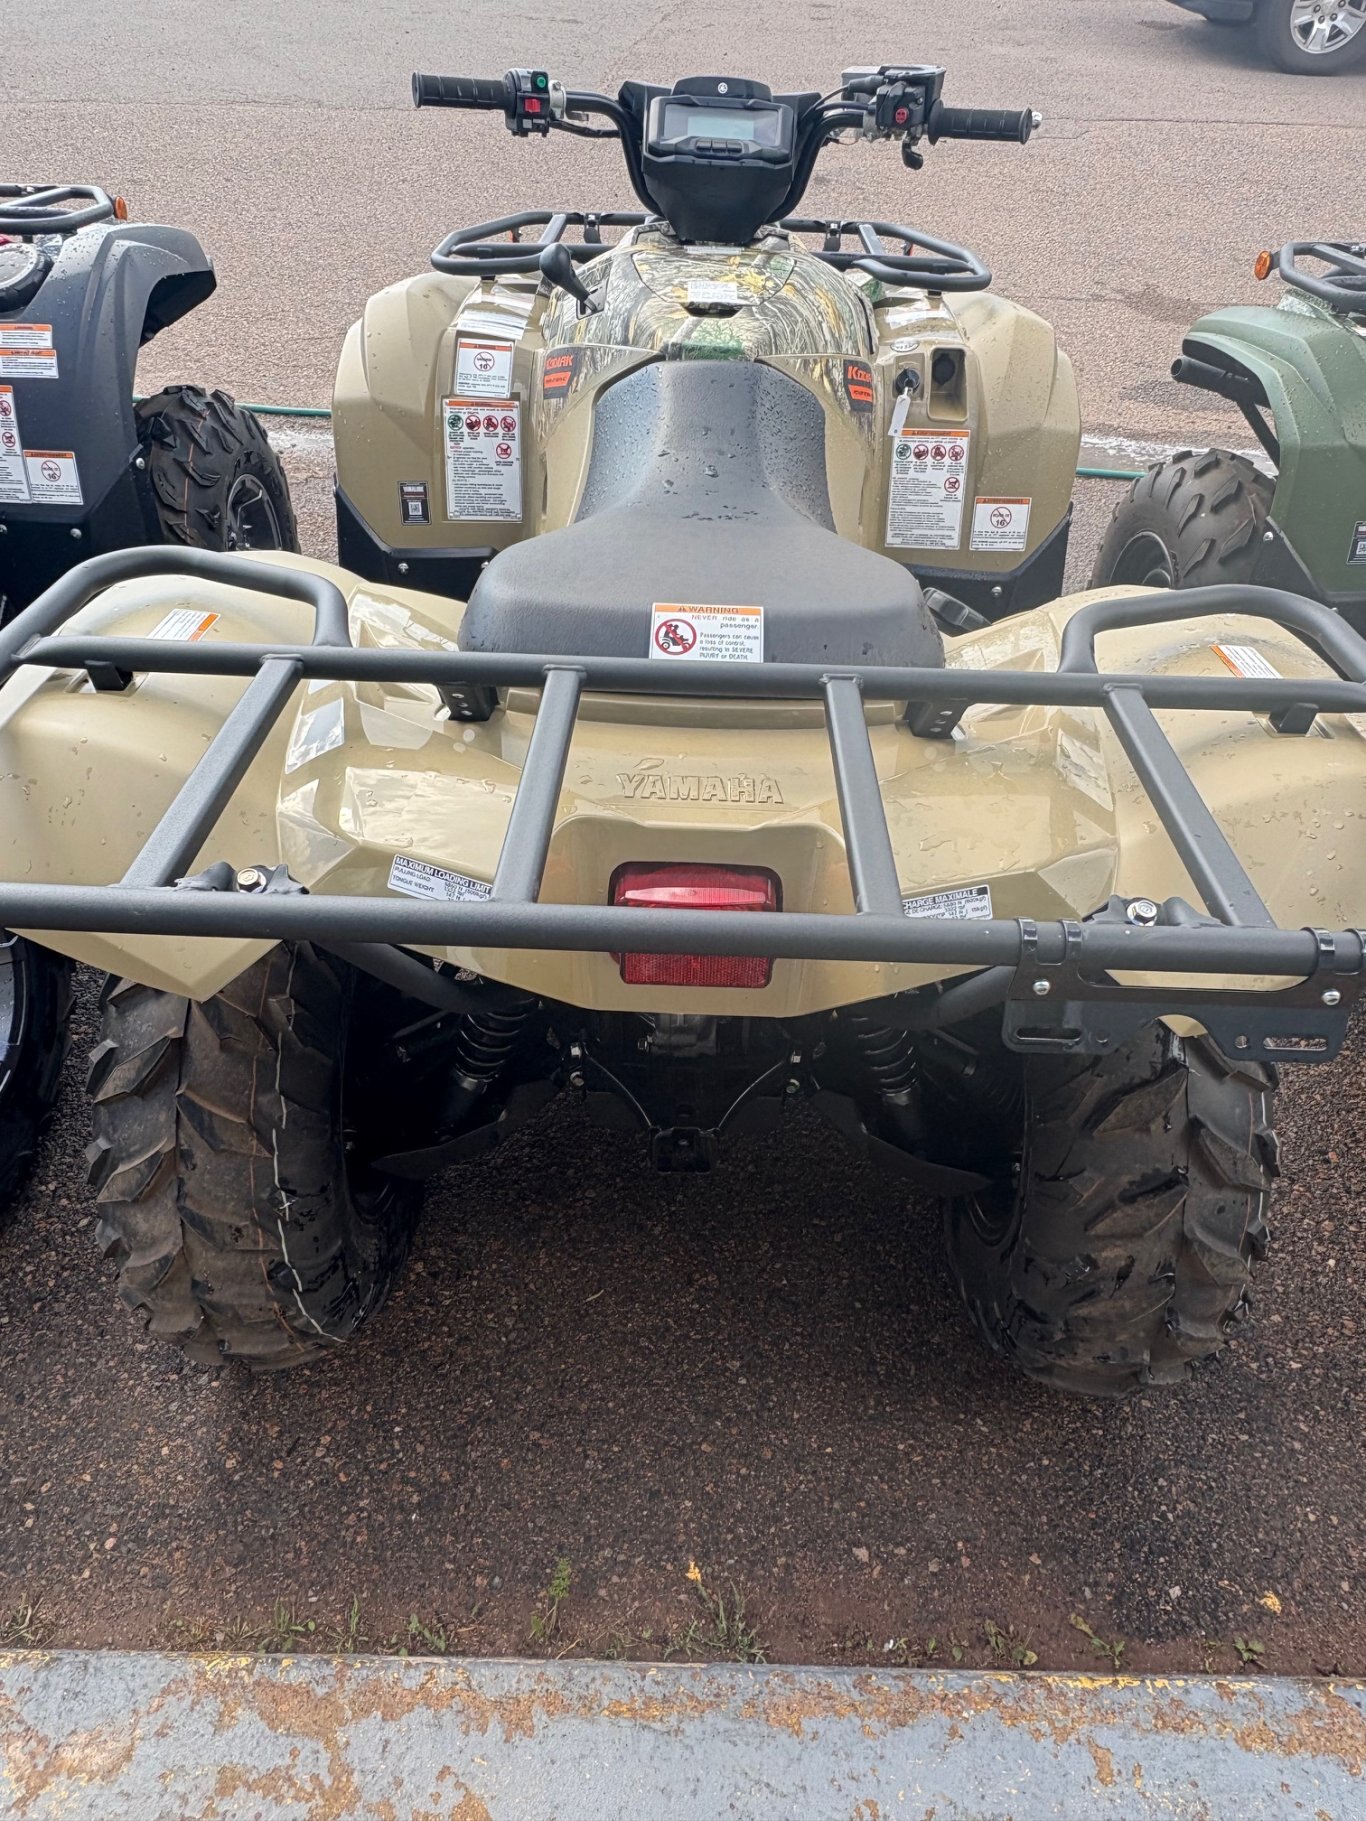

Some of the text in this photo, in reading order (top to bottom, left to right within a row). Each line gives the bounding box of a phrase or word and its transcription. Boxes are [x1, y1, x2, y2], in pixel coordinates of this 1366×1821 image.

[688, 605, 740, 614] WARNING
[719, 622, 760, 630] passenger.
[699, 632, 731, 640] Passengers
[616, 773, 784, 805] YAMAHA
[394, 866, 417, 878] PULLING
[396, 857, 491, 894] MAXIMUM LOADING LIMIT
[392, 874, 414, 886] TONGUE
[935, 888, 978, 904] MAXIMALE
